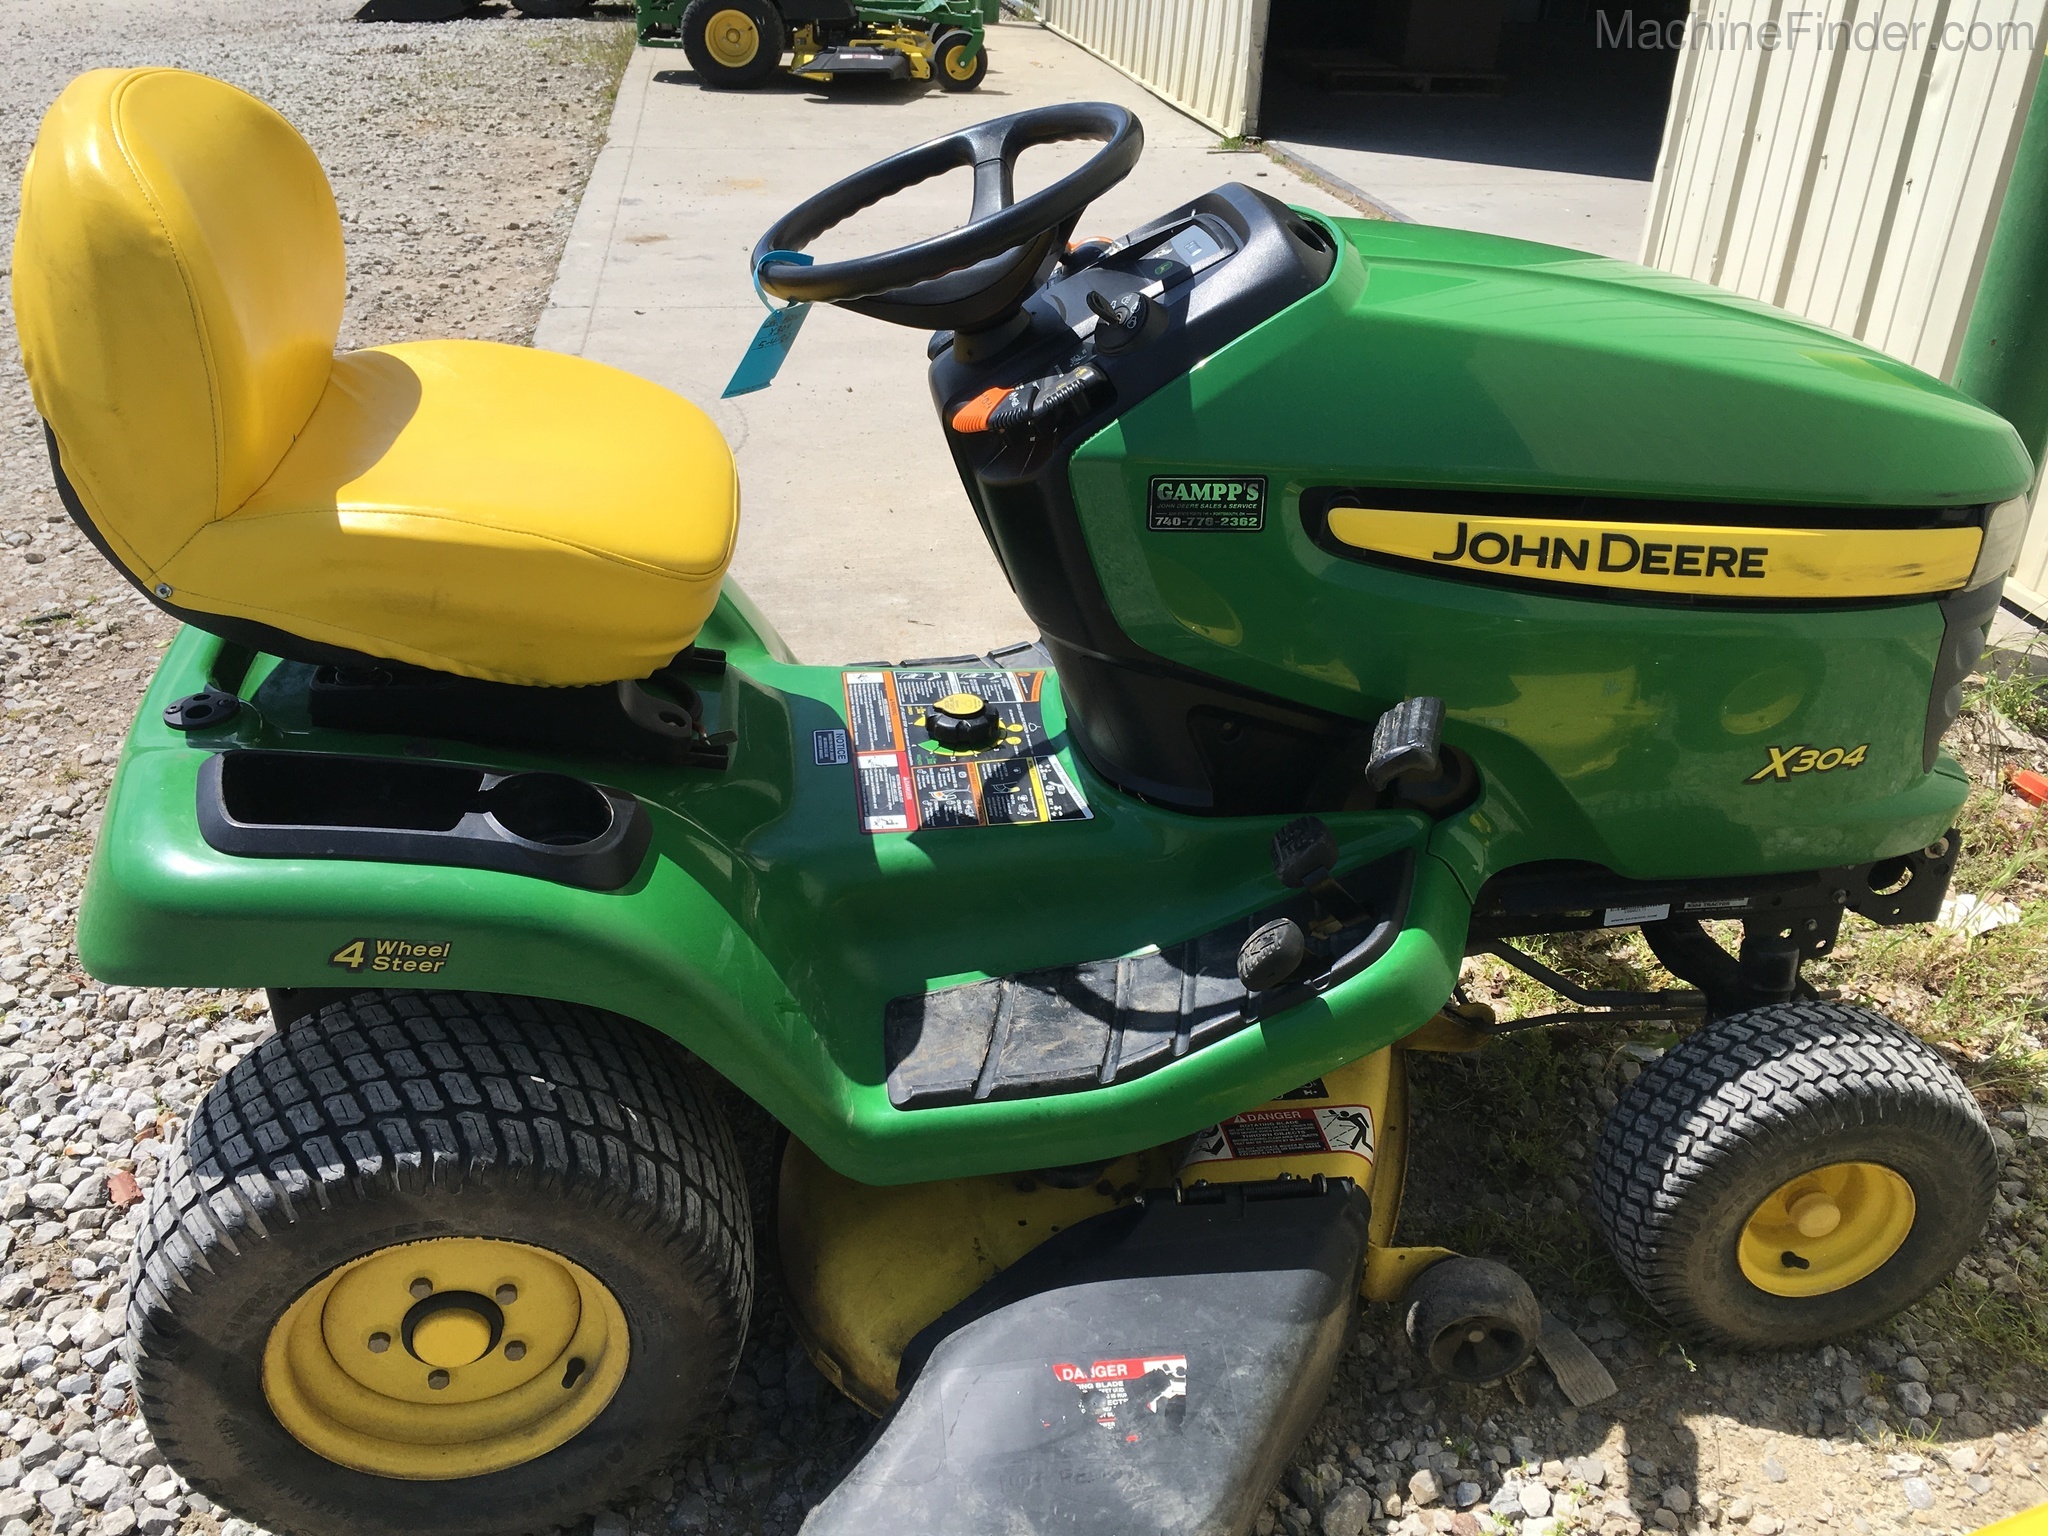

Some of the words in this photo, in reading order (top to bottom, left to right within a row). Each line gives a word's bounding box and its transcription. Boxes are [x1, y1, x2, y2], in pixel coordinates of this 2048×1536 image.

[1156, 482, 1260, 501] GAMPP'S
[1433, 521, 1590, 572] JOHN
[1597, 532, 1769, 579] DEERE
[835, 733, 847, 760] NOTICE
[1748, 743, 1869, 781] X304
[333, 941, 365, 968] 4
[376, 940, 451, 957] Wheel
[372, 956, 445, 973] Steer
[1247, 1111, 1302, 1122] DANGER
[1095, 1380, 1124, 1388] BLADE
